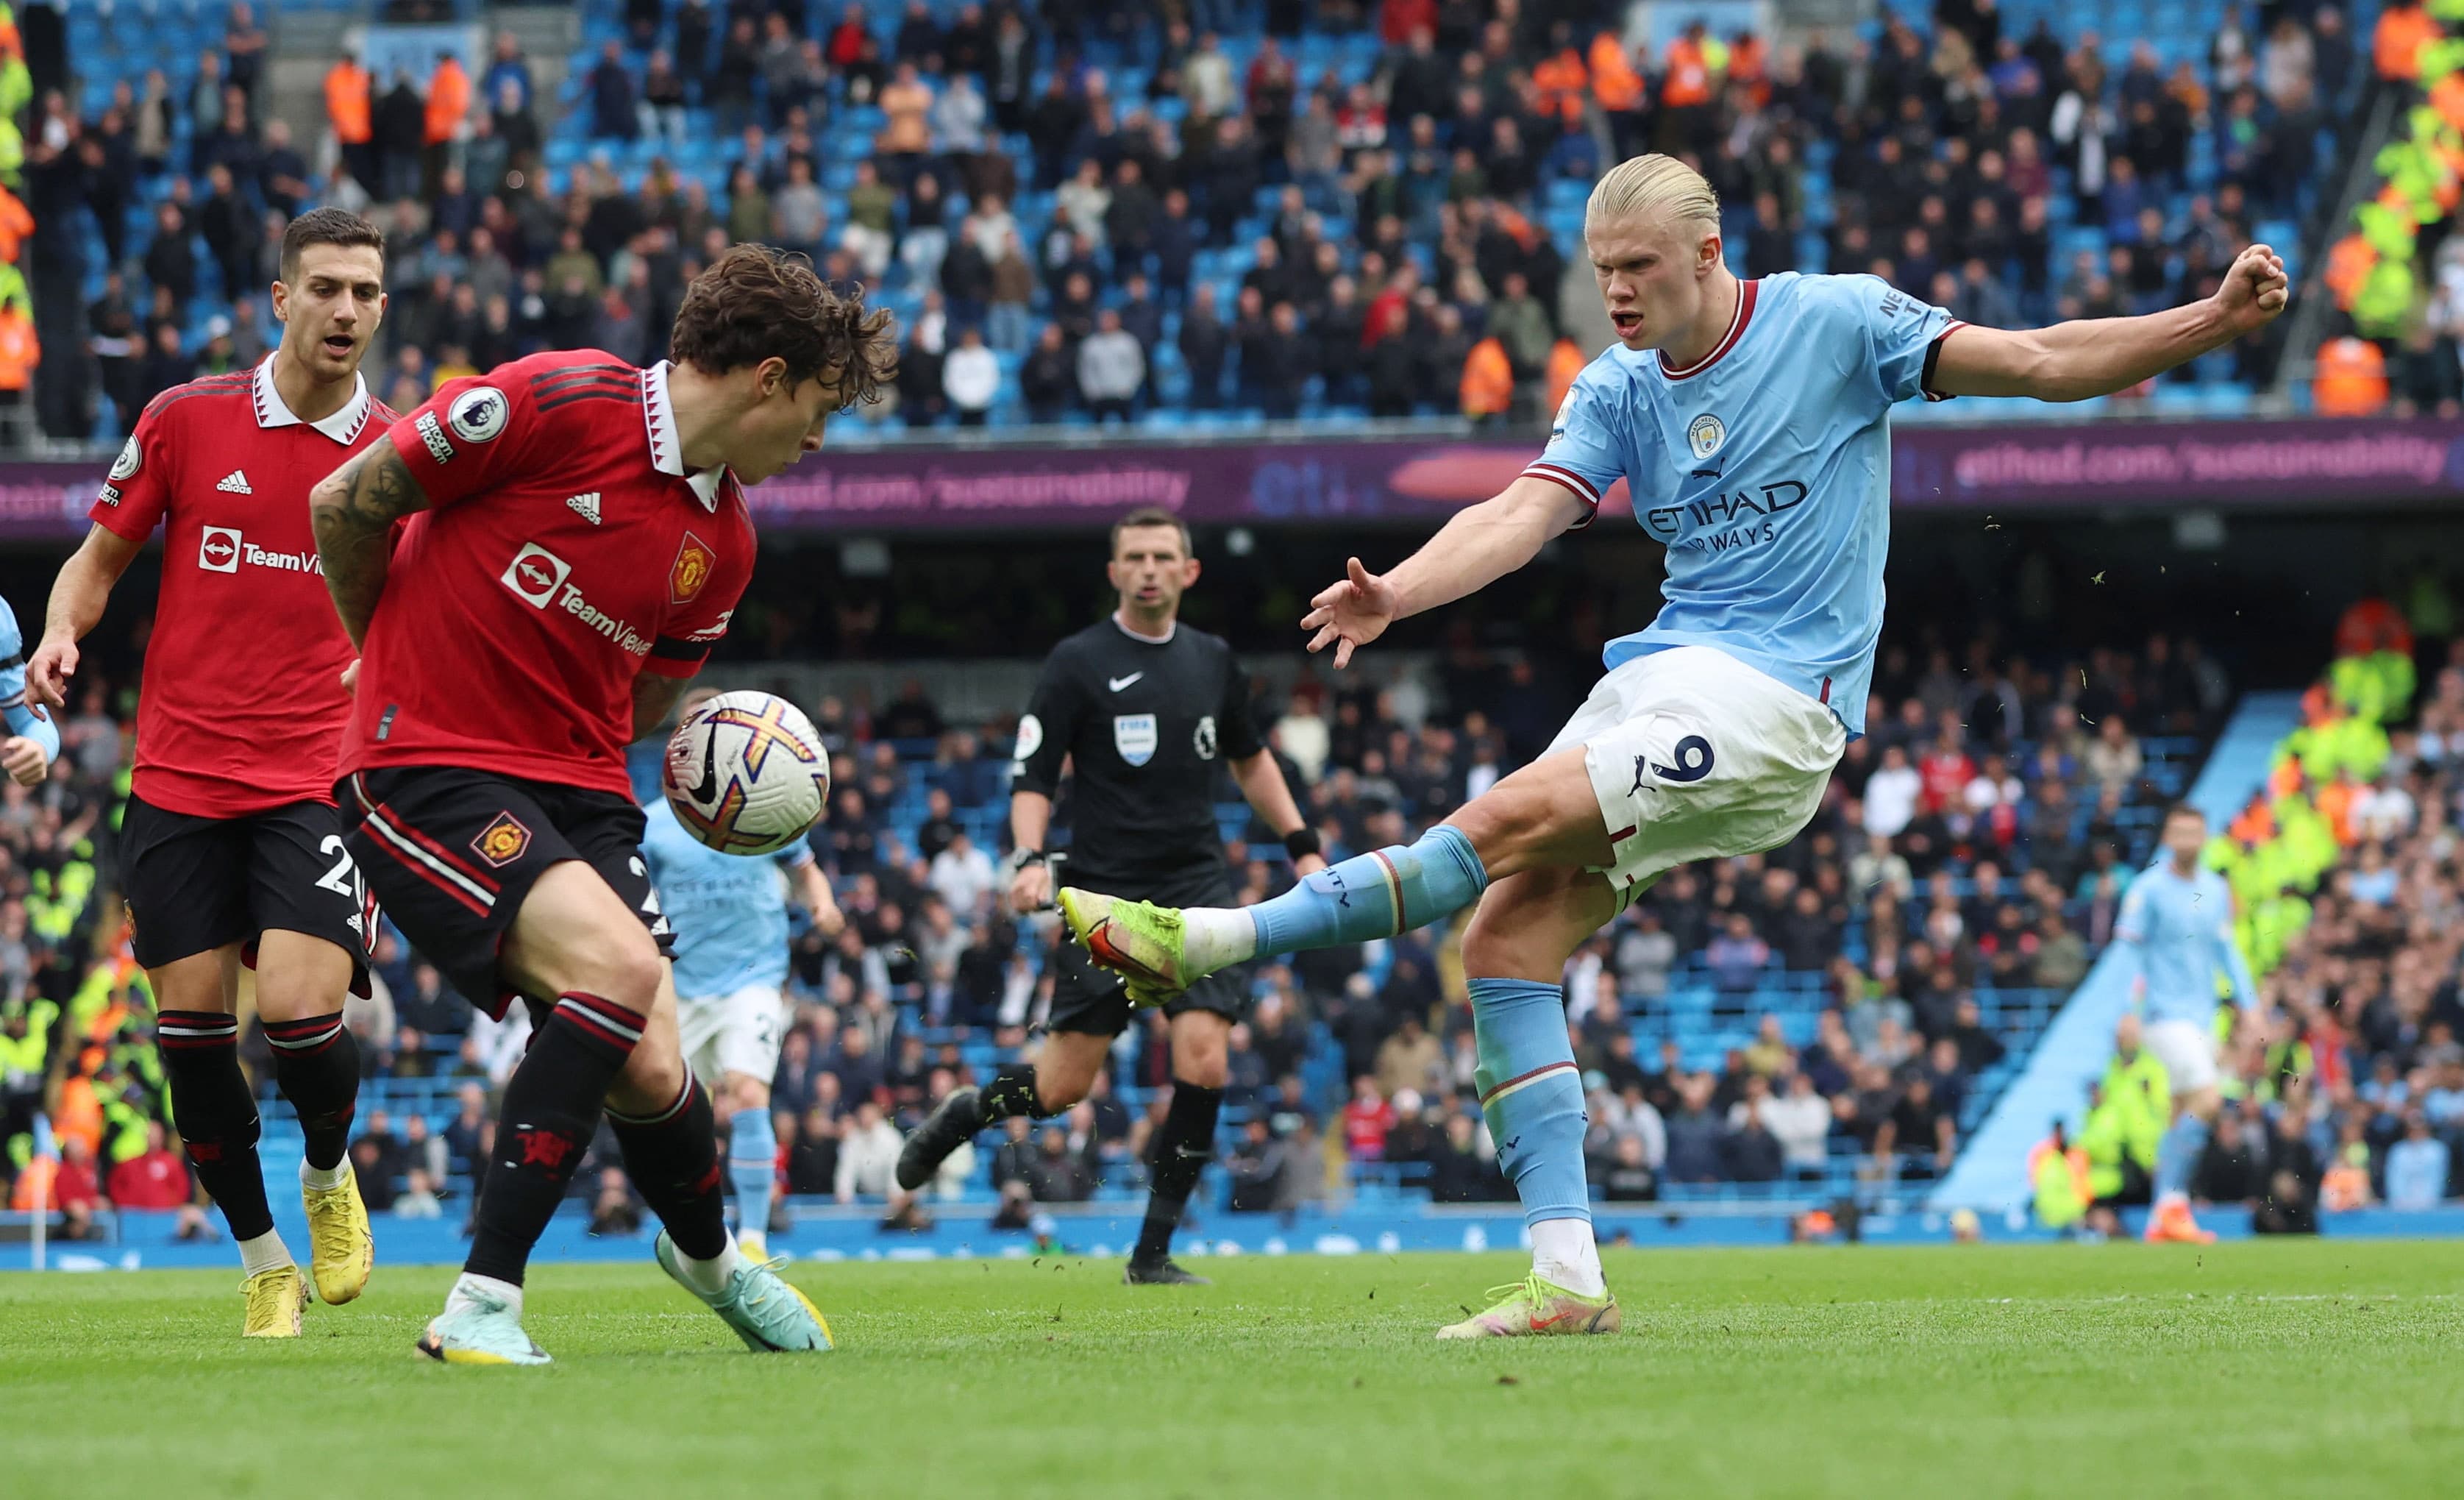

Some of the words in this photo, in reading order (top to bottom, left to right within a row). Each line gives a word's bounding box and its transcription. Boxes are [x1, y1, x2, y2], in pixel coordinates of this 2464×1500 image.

[1691, 417, 1720, 437] MANCHESTER
[216, 482, 253, 495] adidas
[566, 497, 602, 525] adidas
[1648, 480, 1808, 533] ETIHAD
[1686, 522, 1775, 555] IRWAYS
[559, 582, 654, 656] TeamViewer
[1649, 734, 1715, 783] 9
